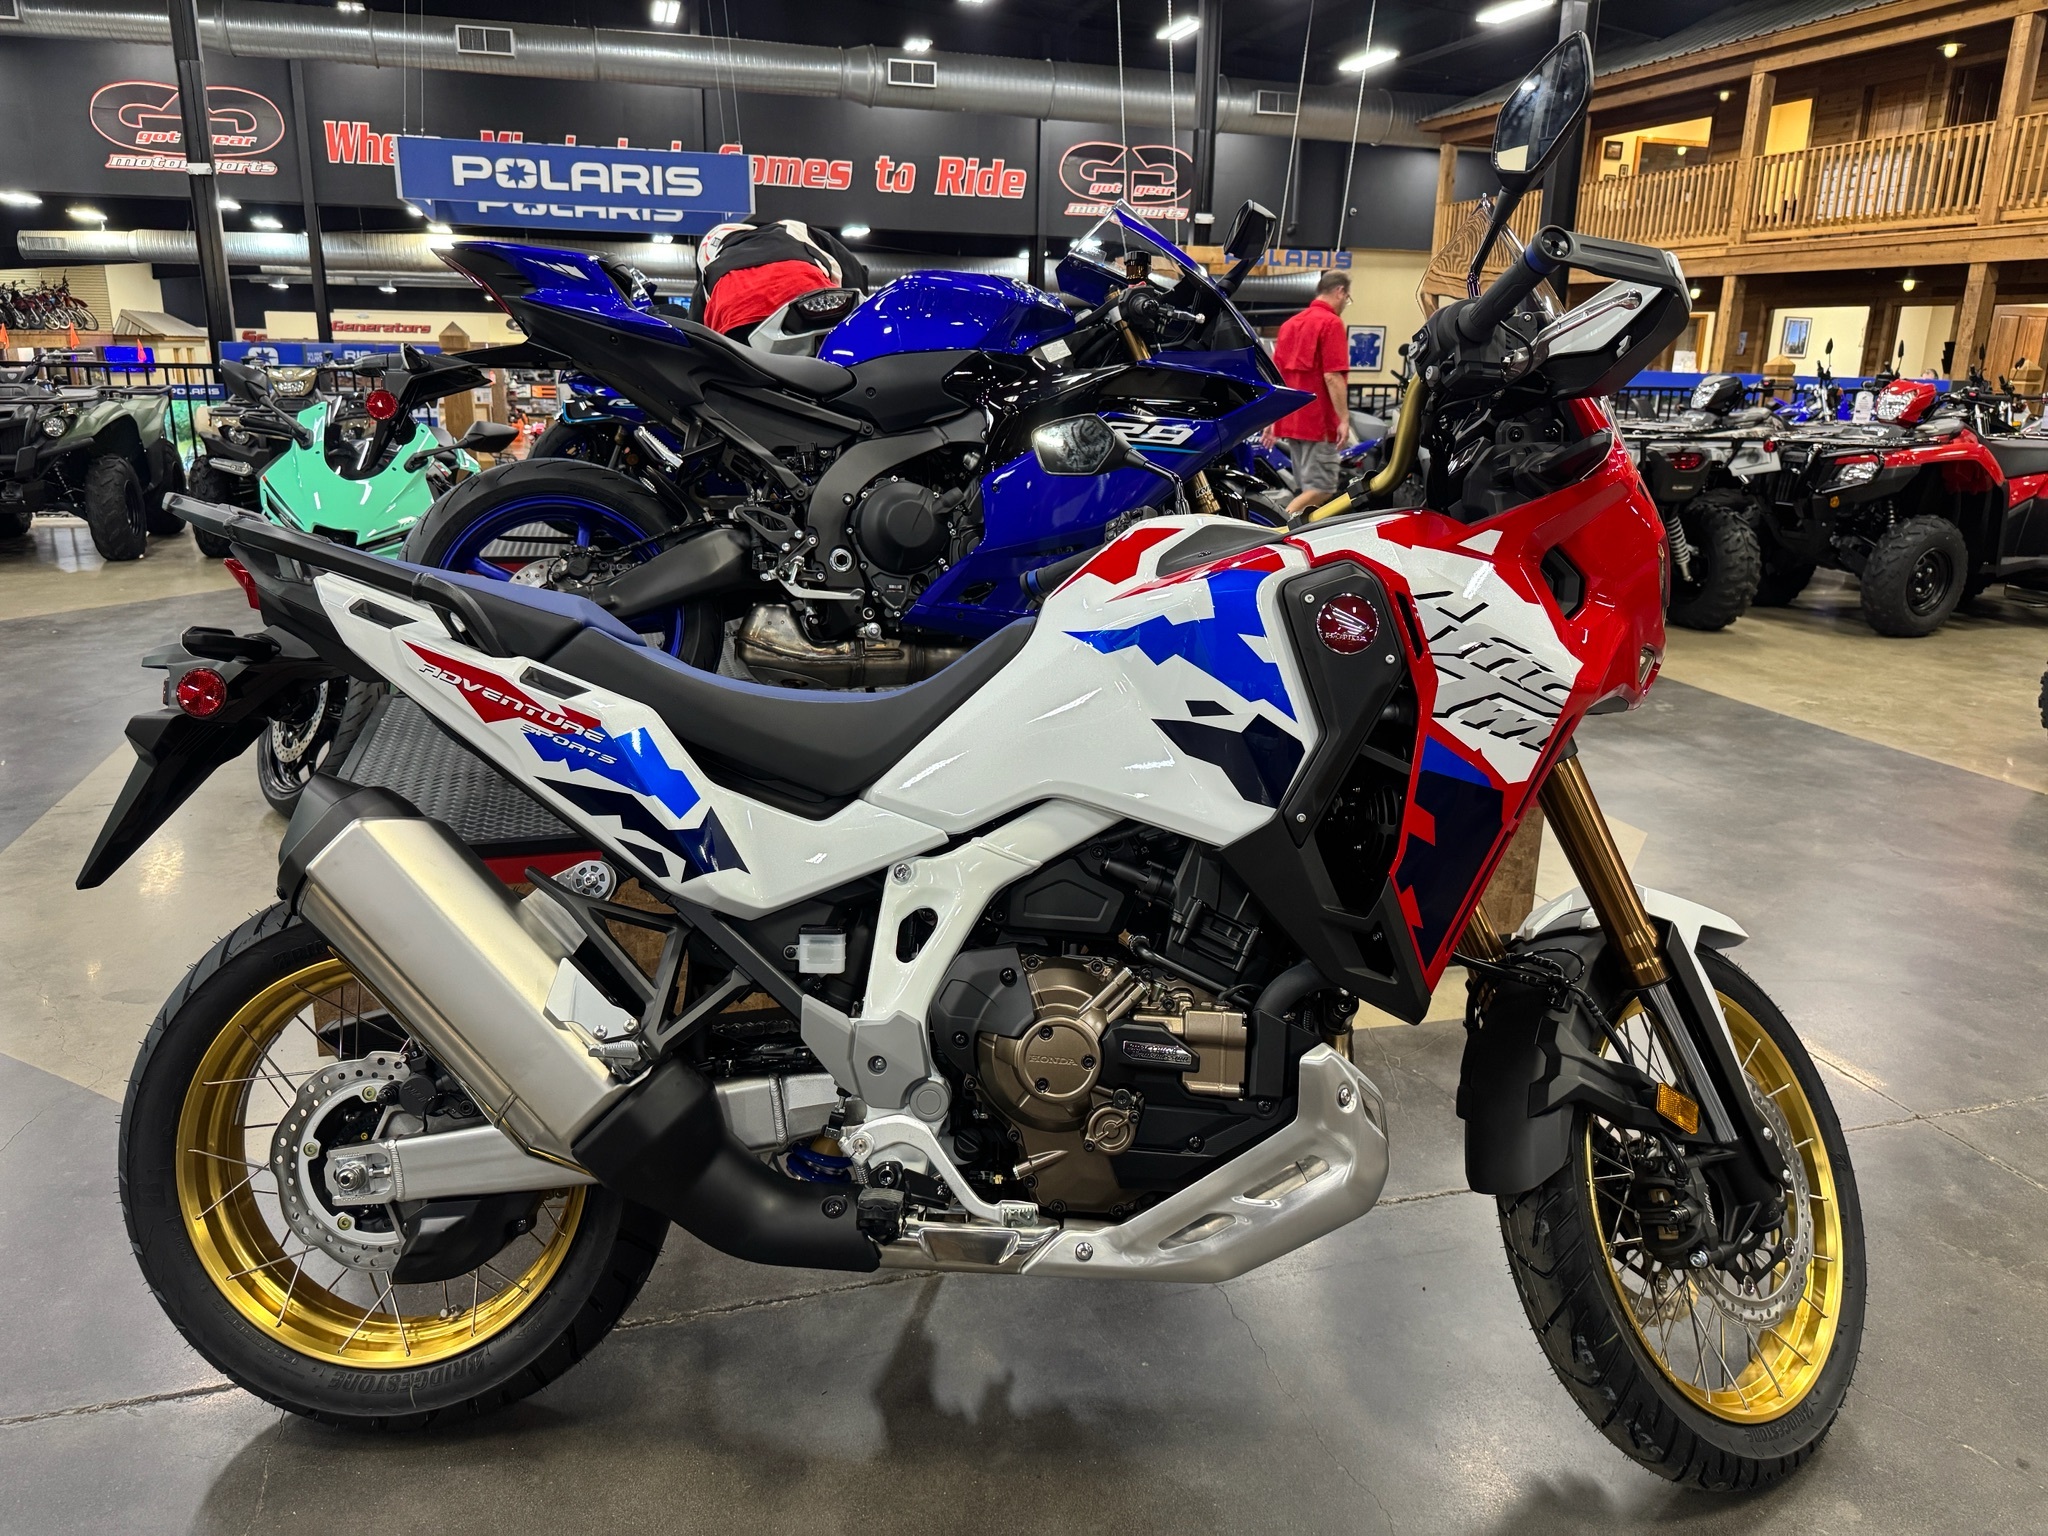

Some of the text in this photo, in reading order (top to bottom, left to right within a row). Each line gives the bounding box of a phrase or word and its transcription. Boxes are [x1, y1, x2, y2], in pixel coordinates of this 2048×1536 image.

[135, 130, 258, 148] got ear
[452, 155, 703, 197] POLARIS
[719, 144, 1027, 199] omes to Ride
[1089, 182, 1178, 197] got gear
[332, 320, 431, 334] Generators
[1325, 632, 1368, 643] HONDA
[419, 663, 606, 743] ADVENTURE
[520, 723, 618, 765] SPORTS
[1028, 1054, 1079, 1067] HONDA
[328, 1348, 486, 1394] BRIDGESTONE
